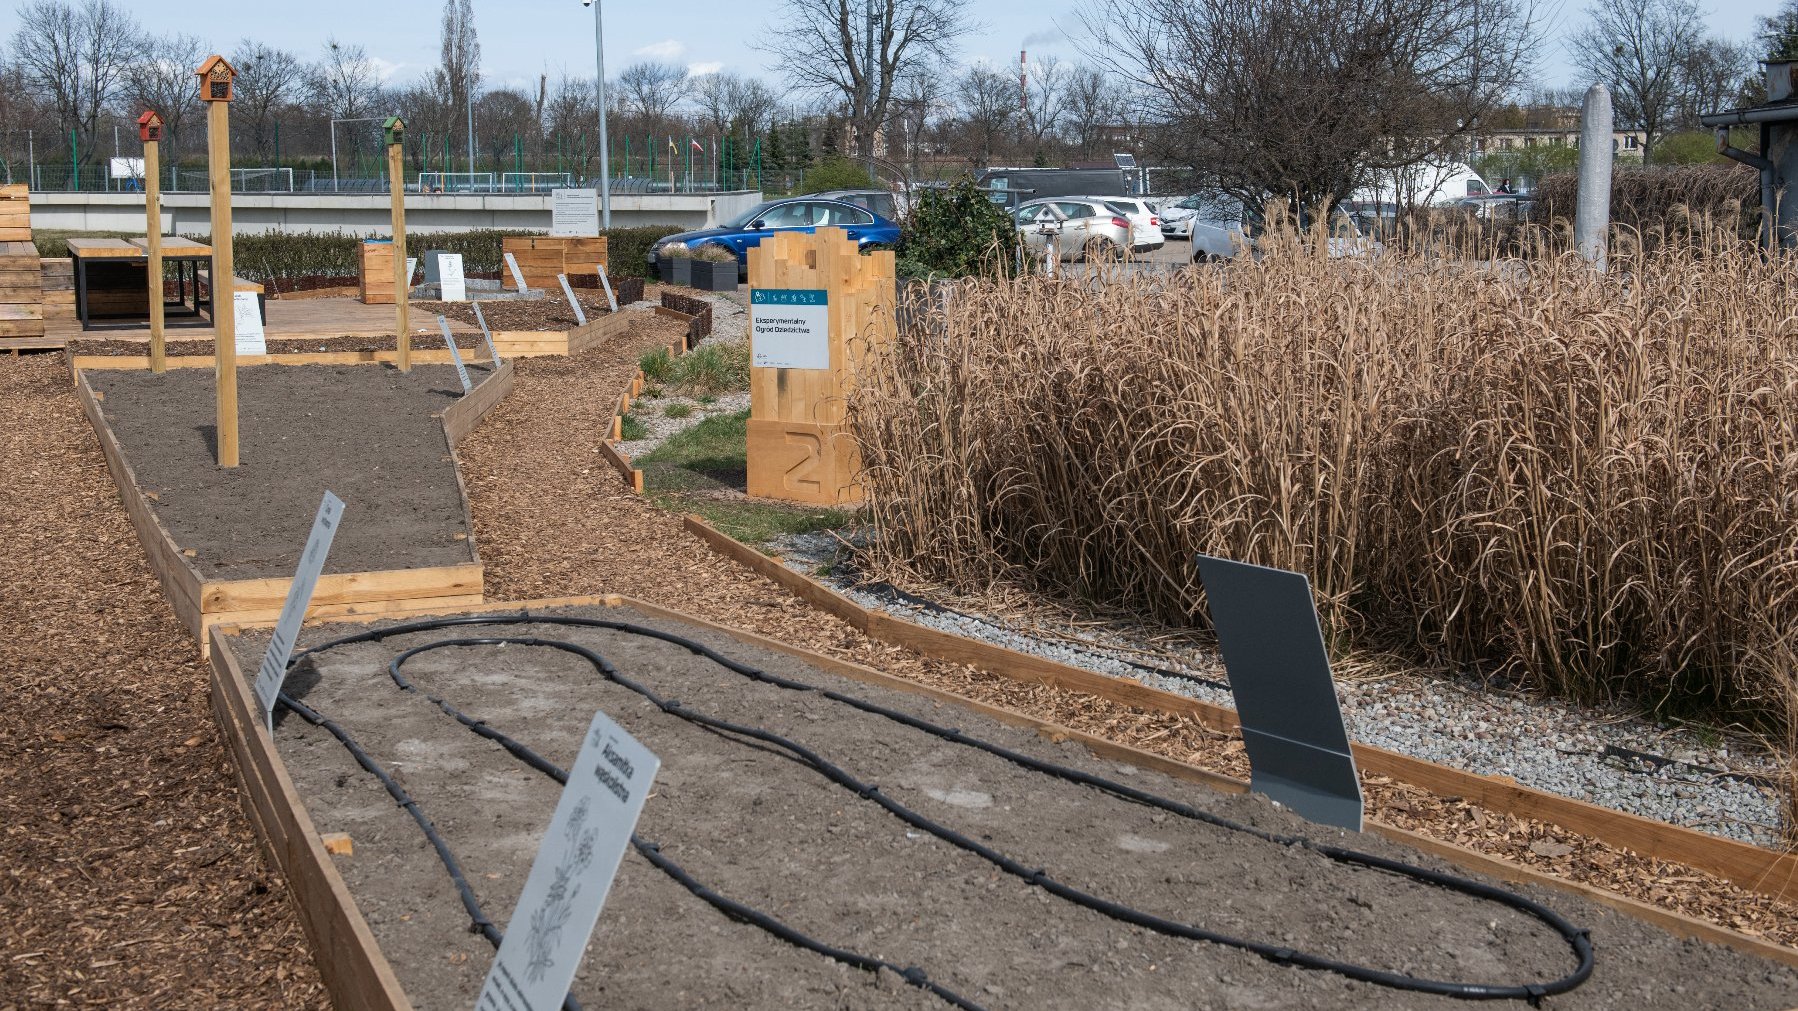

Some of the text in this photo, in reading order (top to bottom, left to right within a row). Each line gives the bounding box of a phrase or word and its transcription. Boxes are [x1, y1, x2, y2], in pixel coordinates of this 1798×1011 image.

[755, 317, 807, 326] Eksperymentalny
[755, 325, 774, 334] Ogród
[784, 431, 821, 493] 2
